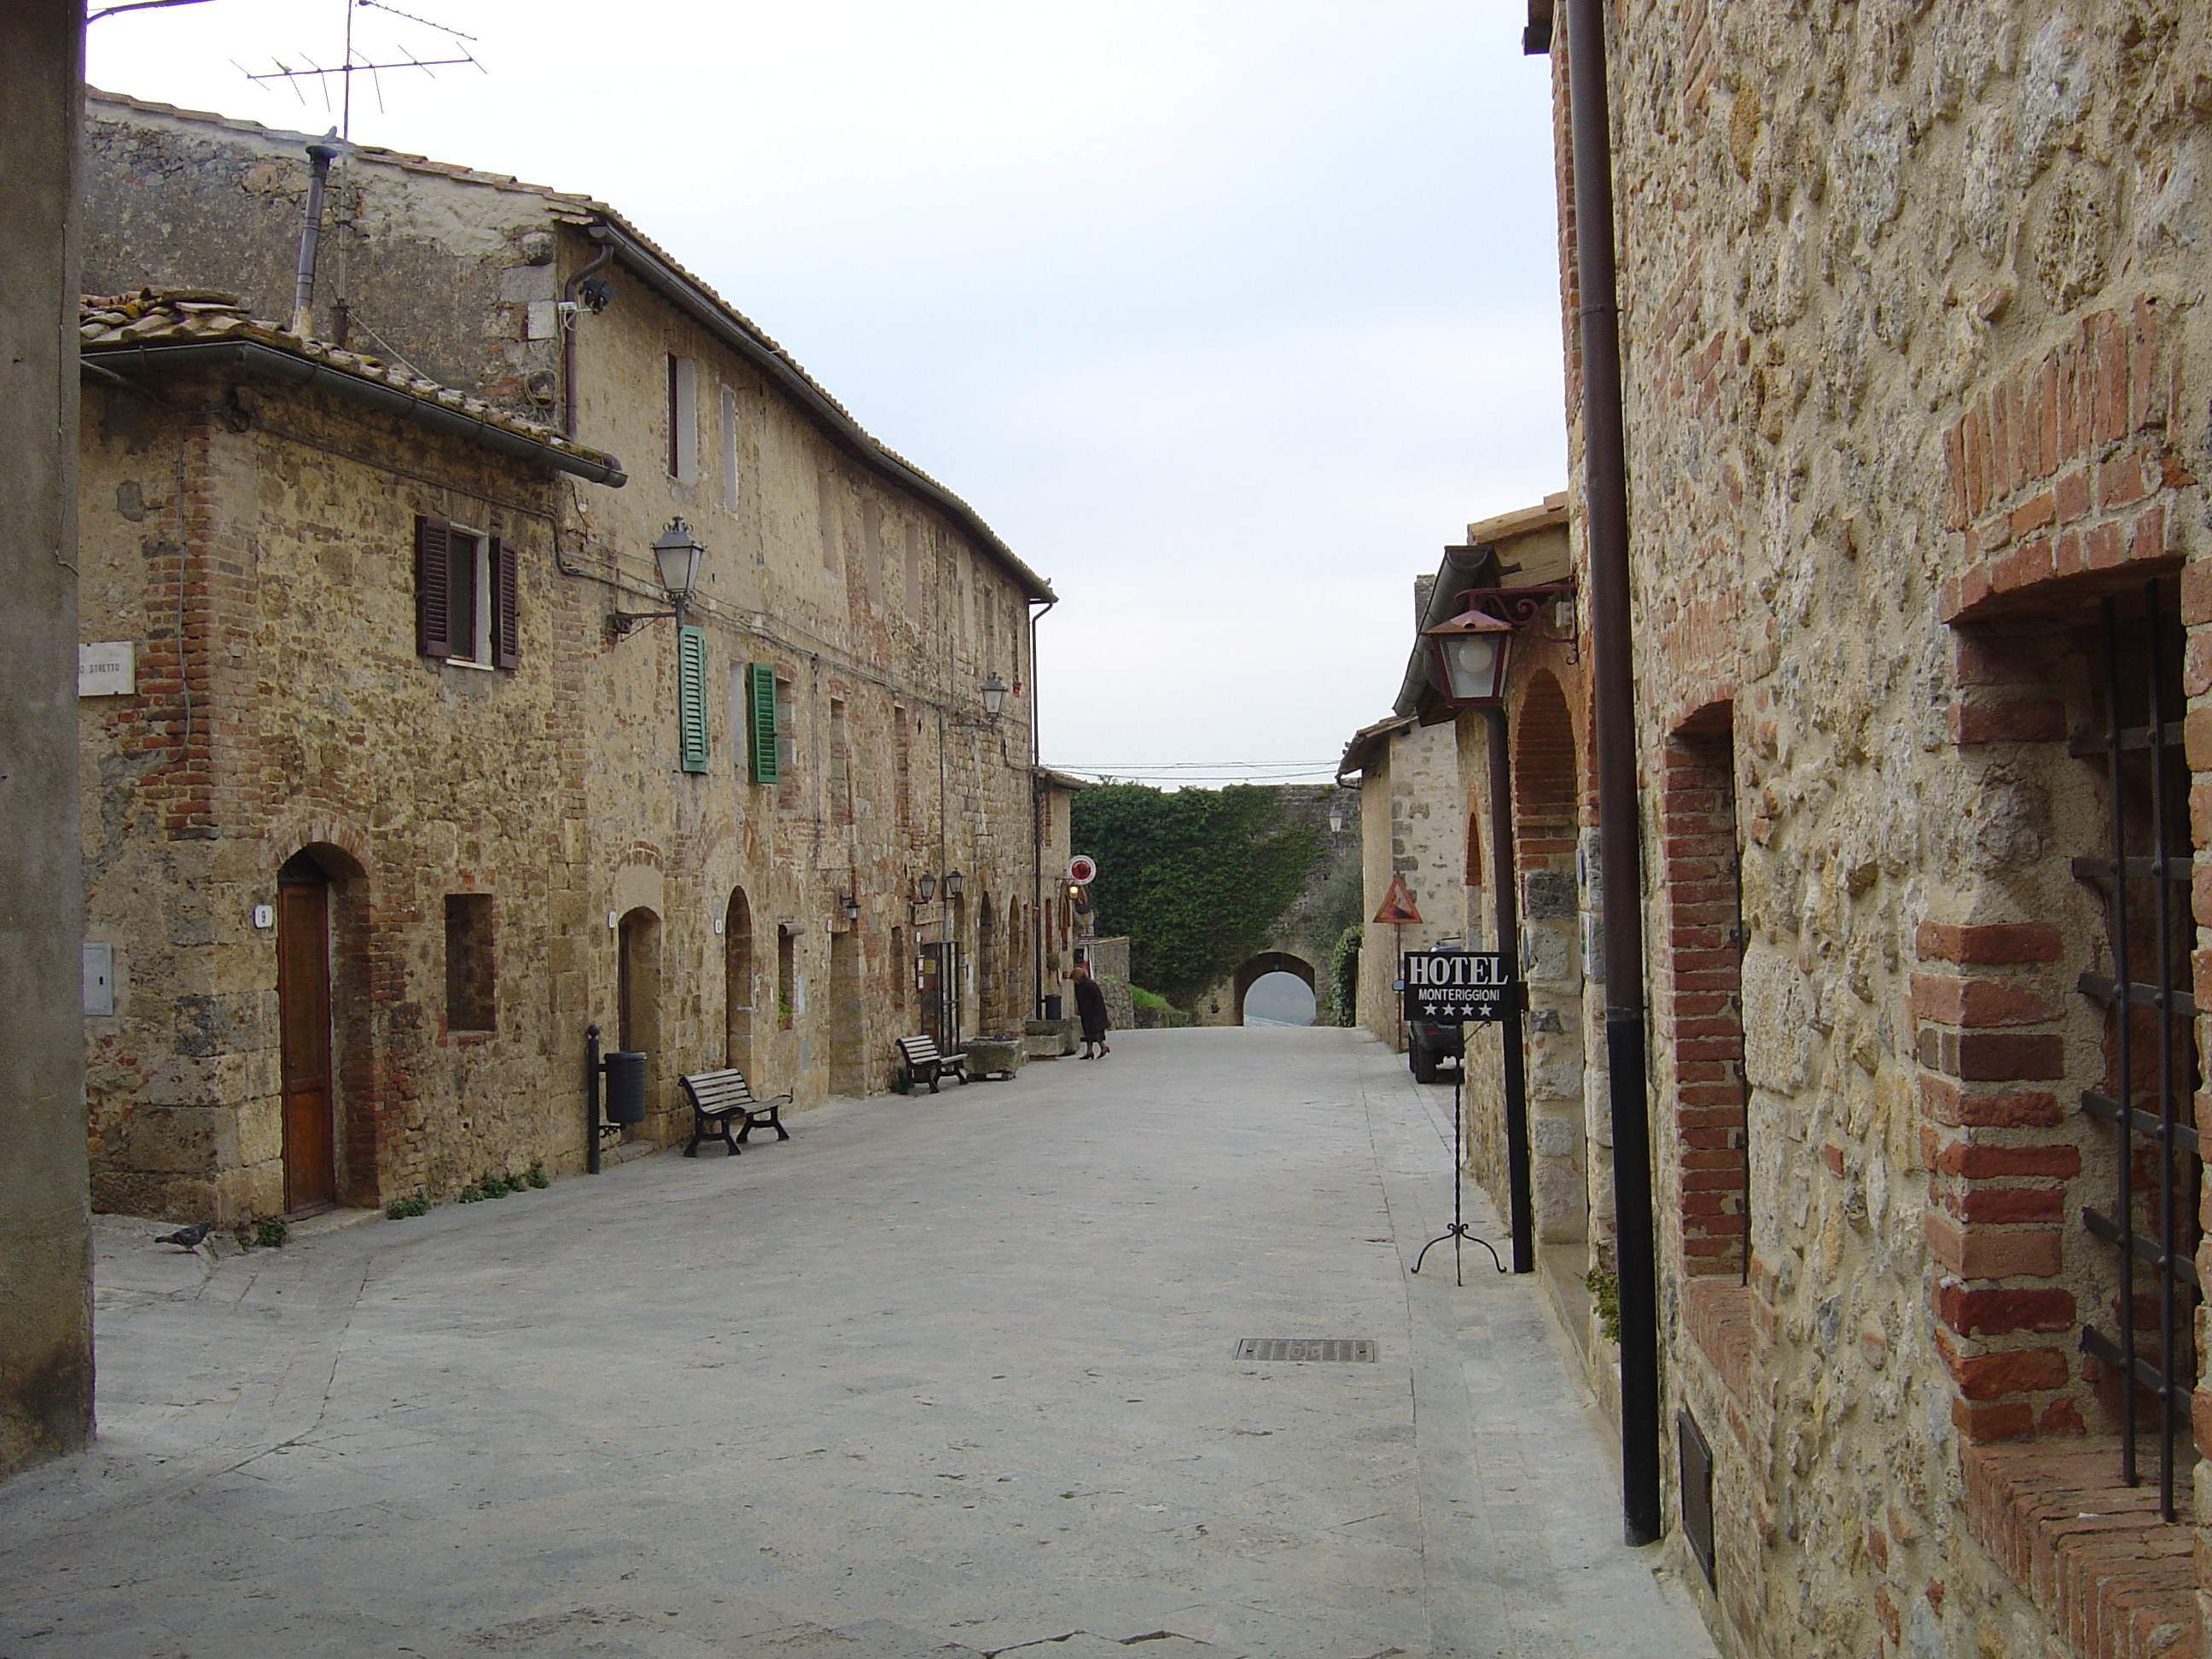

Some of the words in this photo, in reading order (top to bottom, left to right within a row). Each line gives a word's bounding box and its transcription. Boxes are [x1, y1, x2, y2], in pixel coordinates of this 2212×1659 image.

[90, 663, 119, 673] STRETTO
[261, 910, 266, 923] 9
[1409, 957, 1509, 986] HOTEL
[1418, 988, 1500, 1001] MONTERIGGIONI
